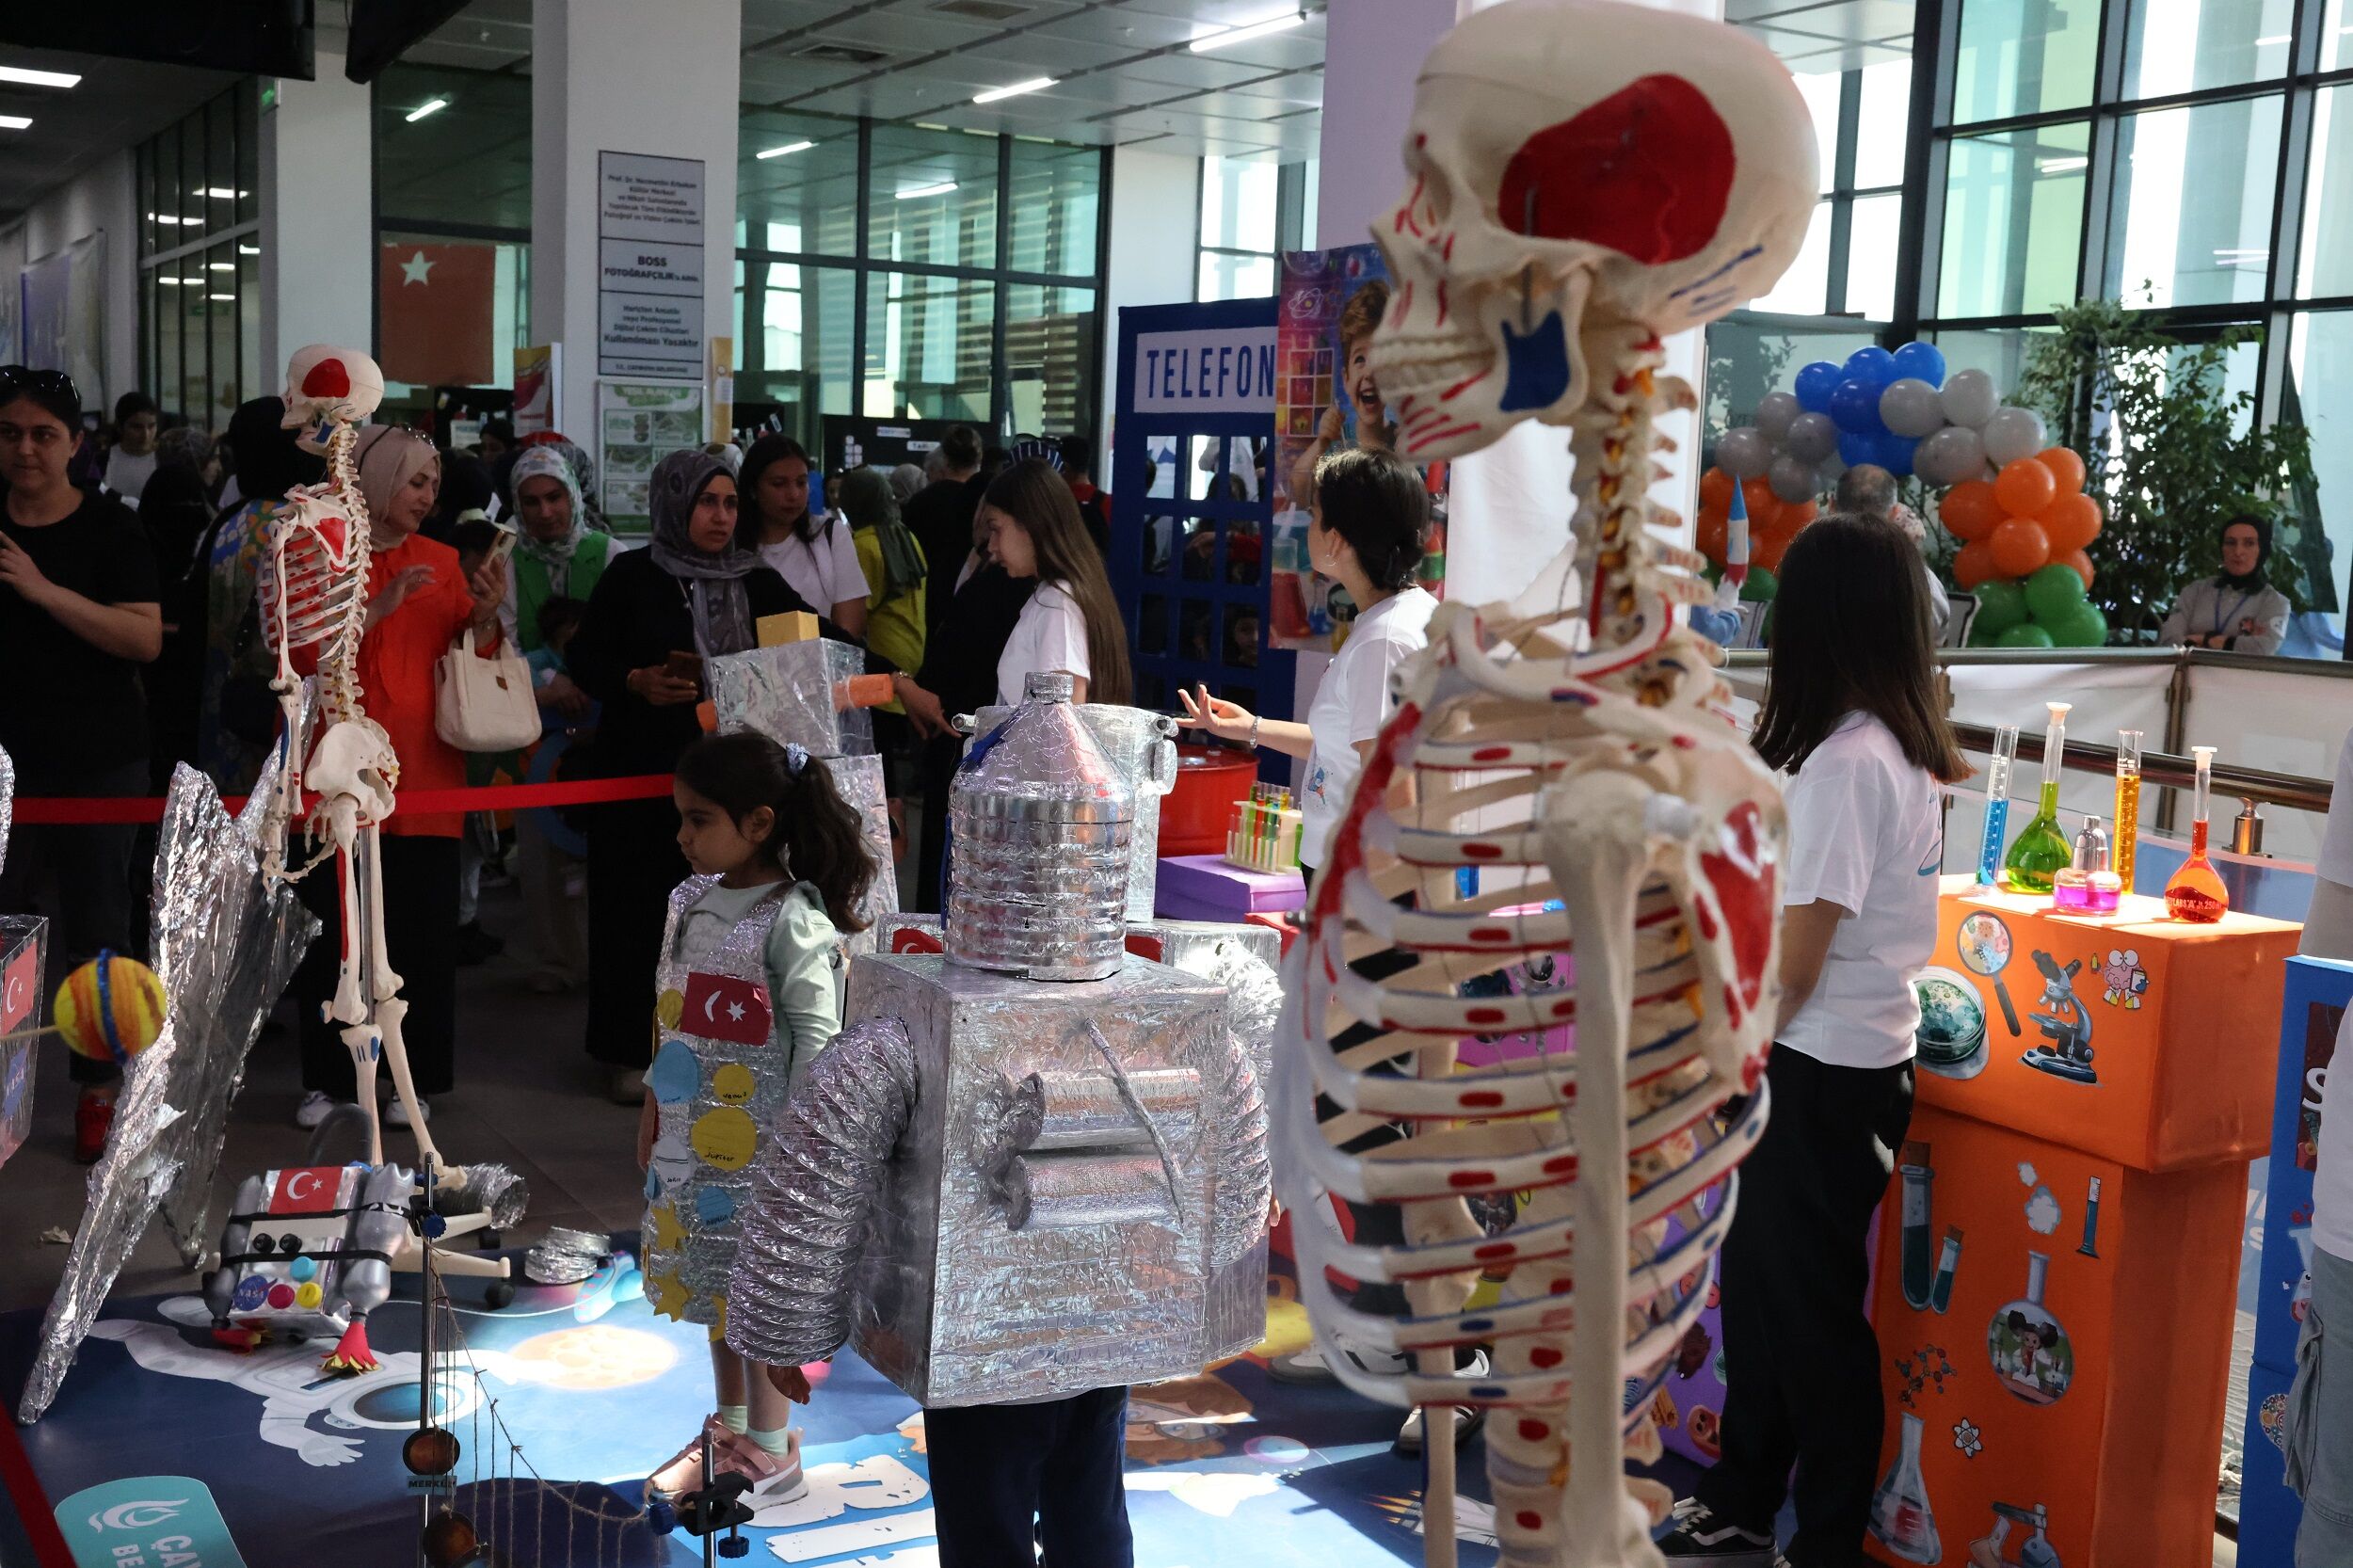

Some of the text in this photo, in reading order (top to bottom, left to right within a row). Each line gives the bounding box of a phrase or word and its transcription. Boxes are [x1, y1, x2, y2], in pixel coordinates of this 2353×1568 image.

[637, 255, 667, 267] BOSS
[1146, 344, 1275, 398] TELEFON
[239, 1287, 265, 1299] NASA
